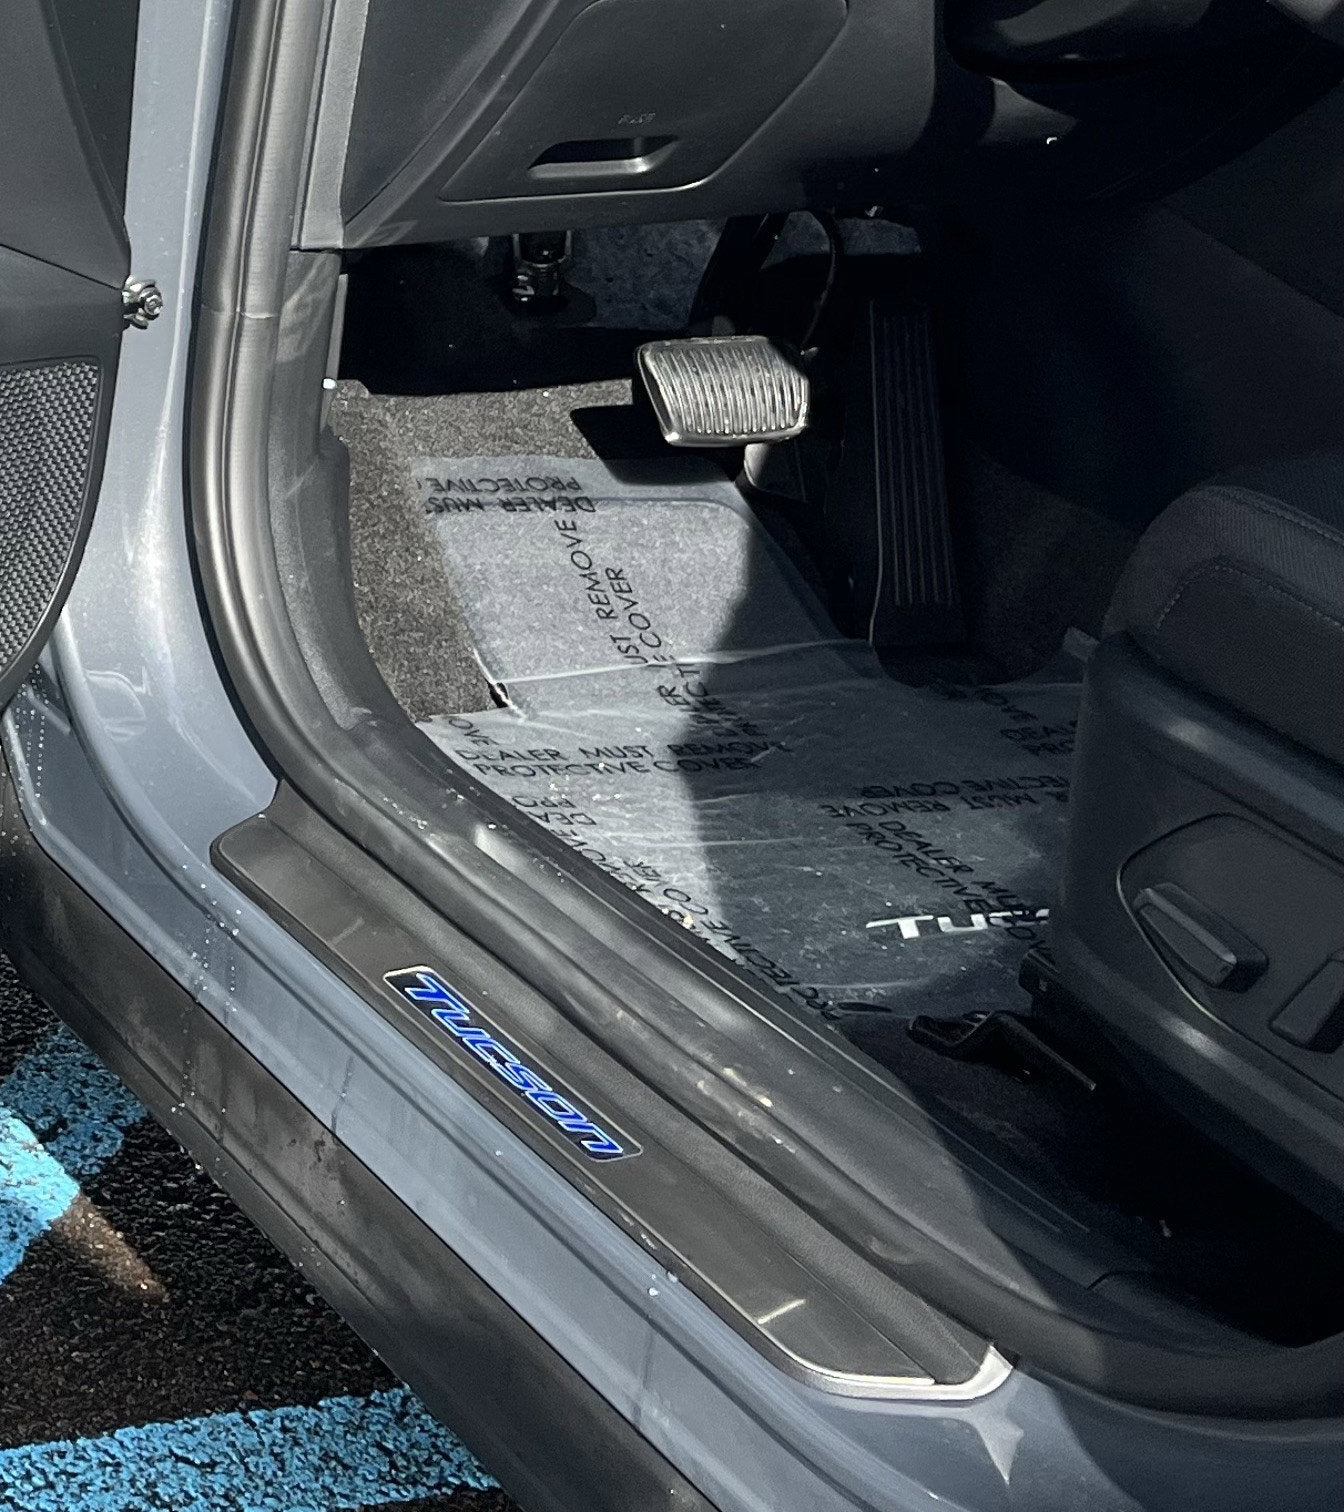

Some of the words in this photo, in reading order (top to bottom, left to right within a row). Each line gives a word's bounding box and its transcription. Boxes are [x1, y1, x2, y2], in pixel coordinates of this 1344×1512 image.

[425, 477, 583, 493] PROTECTIVE
[498, 496, 597, 513] DEALER
[555, 518, 619, 621] REMOVE
[605, 567, 662, 648] COVER
[579, 744, 654, 760] MUST
[472, 760, 651, 777] PROTECTIVE
[654, 757, 763, 774] COVER
[820, 800, 951, 818] REMOVE
[878, 820, 975, 875] DEALER
[845, 822, 993, 914] PROTECTIVE
